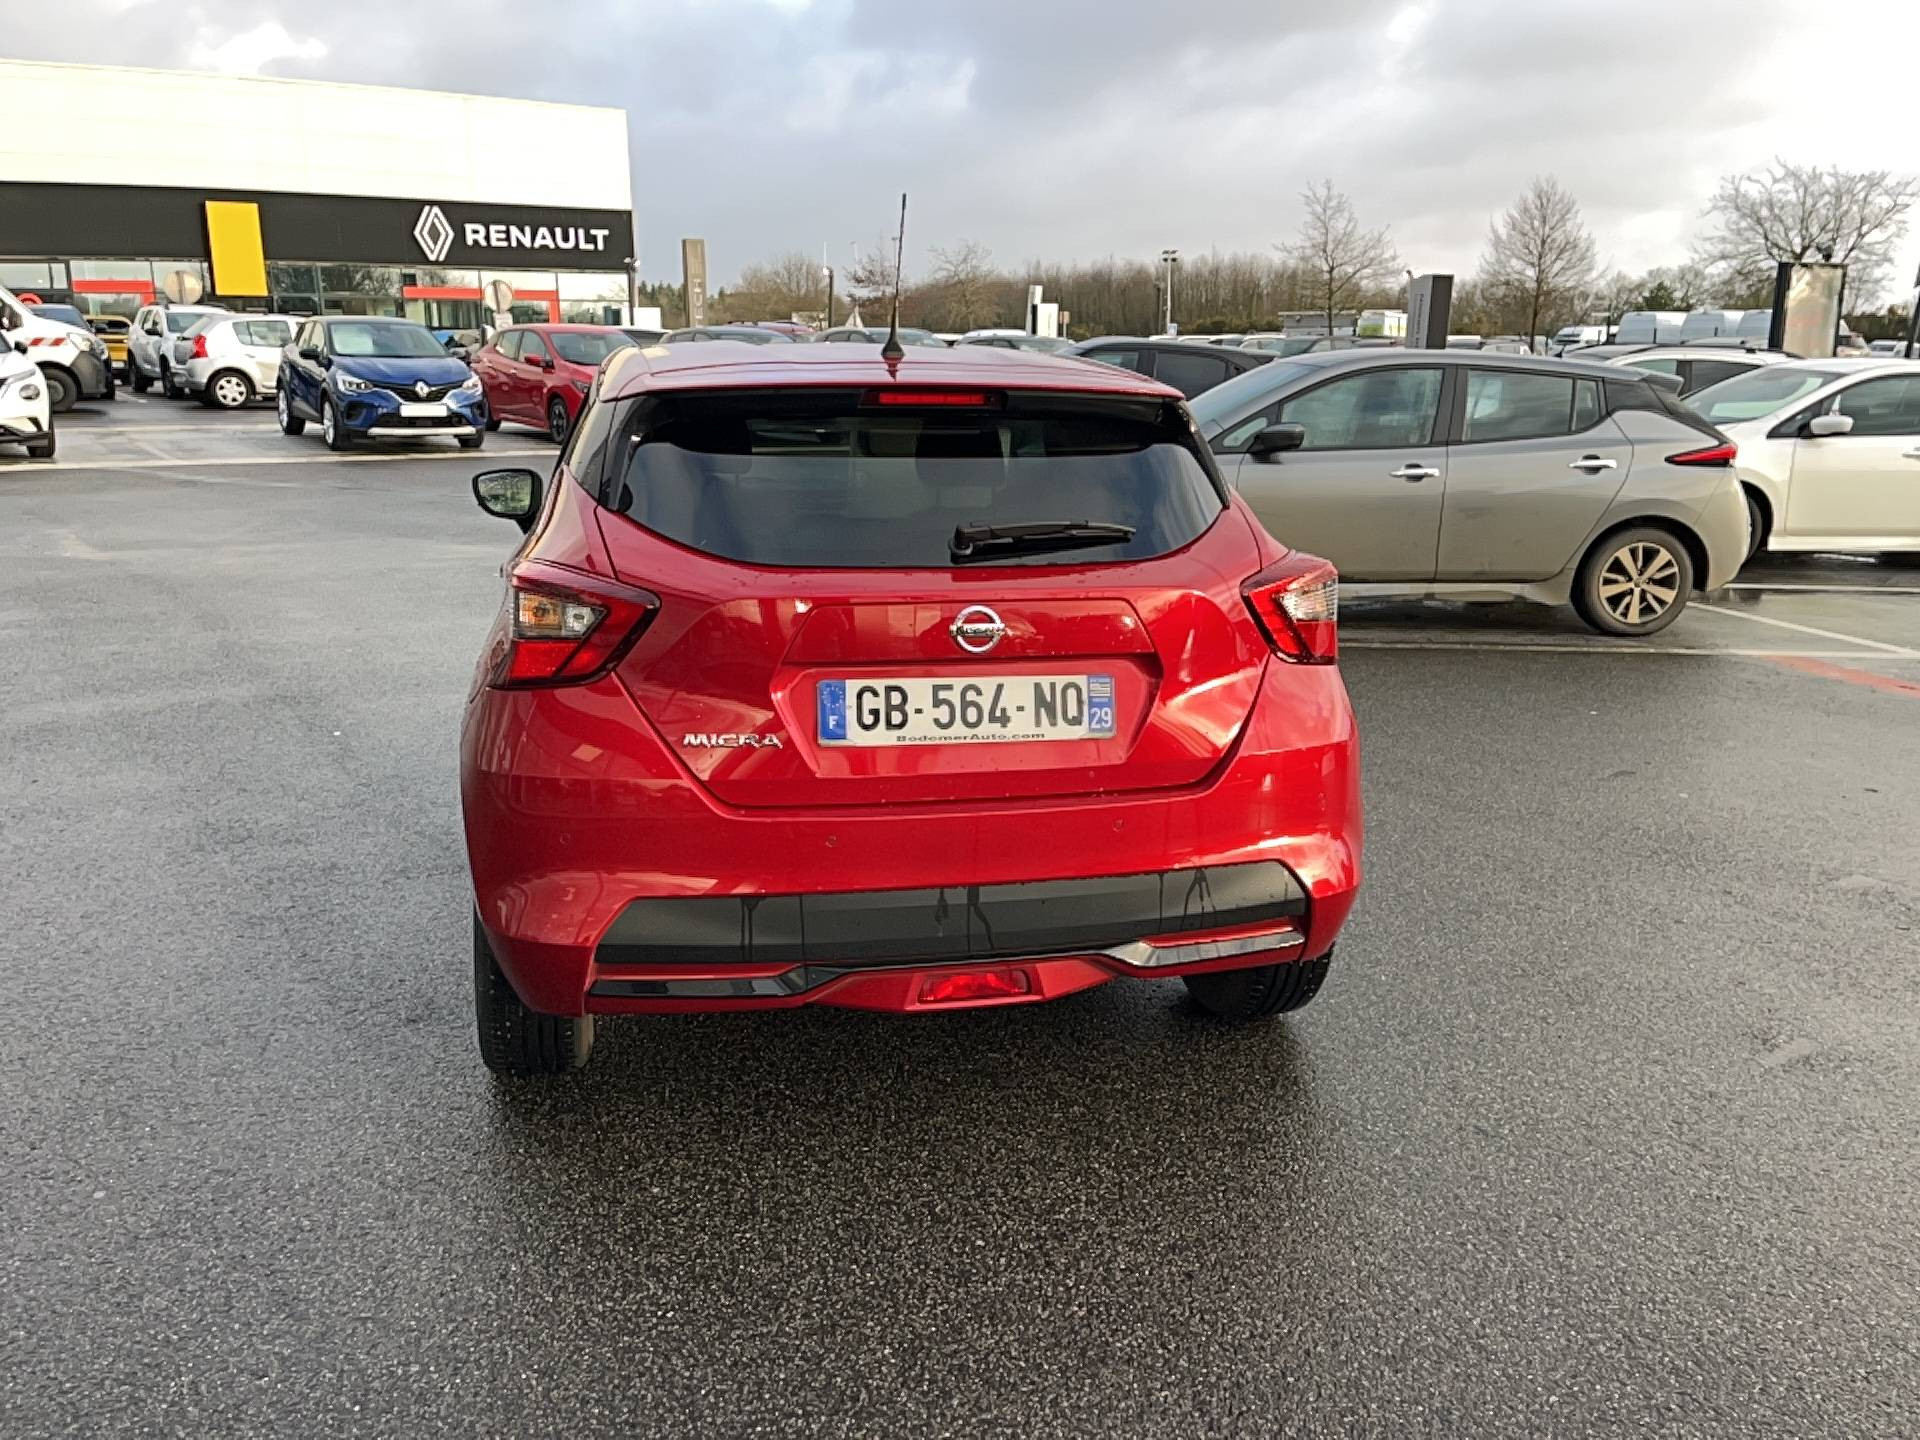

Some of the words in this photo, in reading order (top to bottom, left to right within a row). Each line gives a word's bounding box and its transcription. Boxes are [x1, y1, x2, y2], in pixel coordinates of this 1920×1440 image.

[464, 223, 609, 250] RENAULT
[856, 681, 1084, 731] GB-564-NQ
[828, 715, 839, 730] F
[1090, 707, 1113, 729] 29
[683, 733, 783, 749] MICRA
